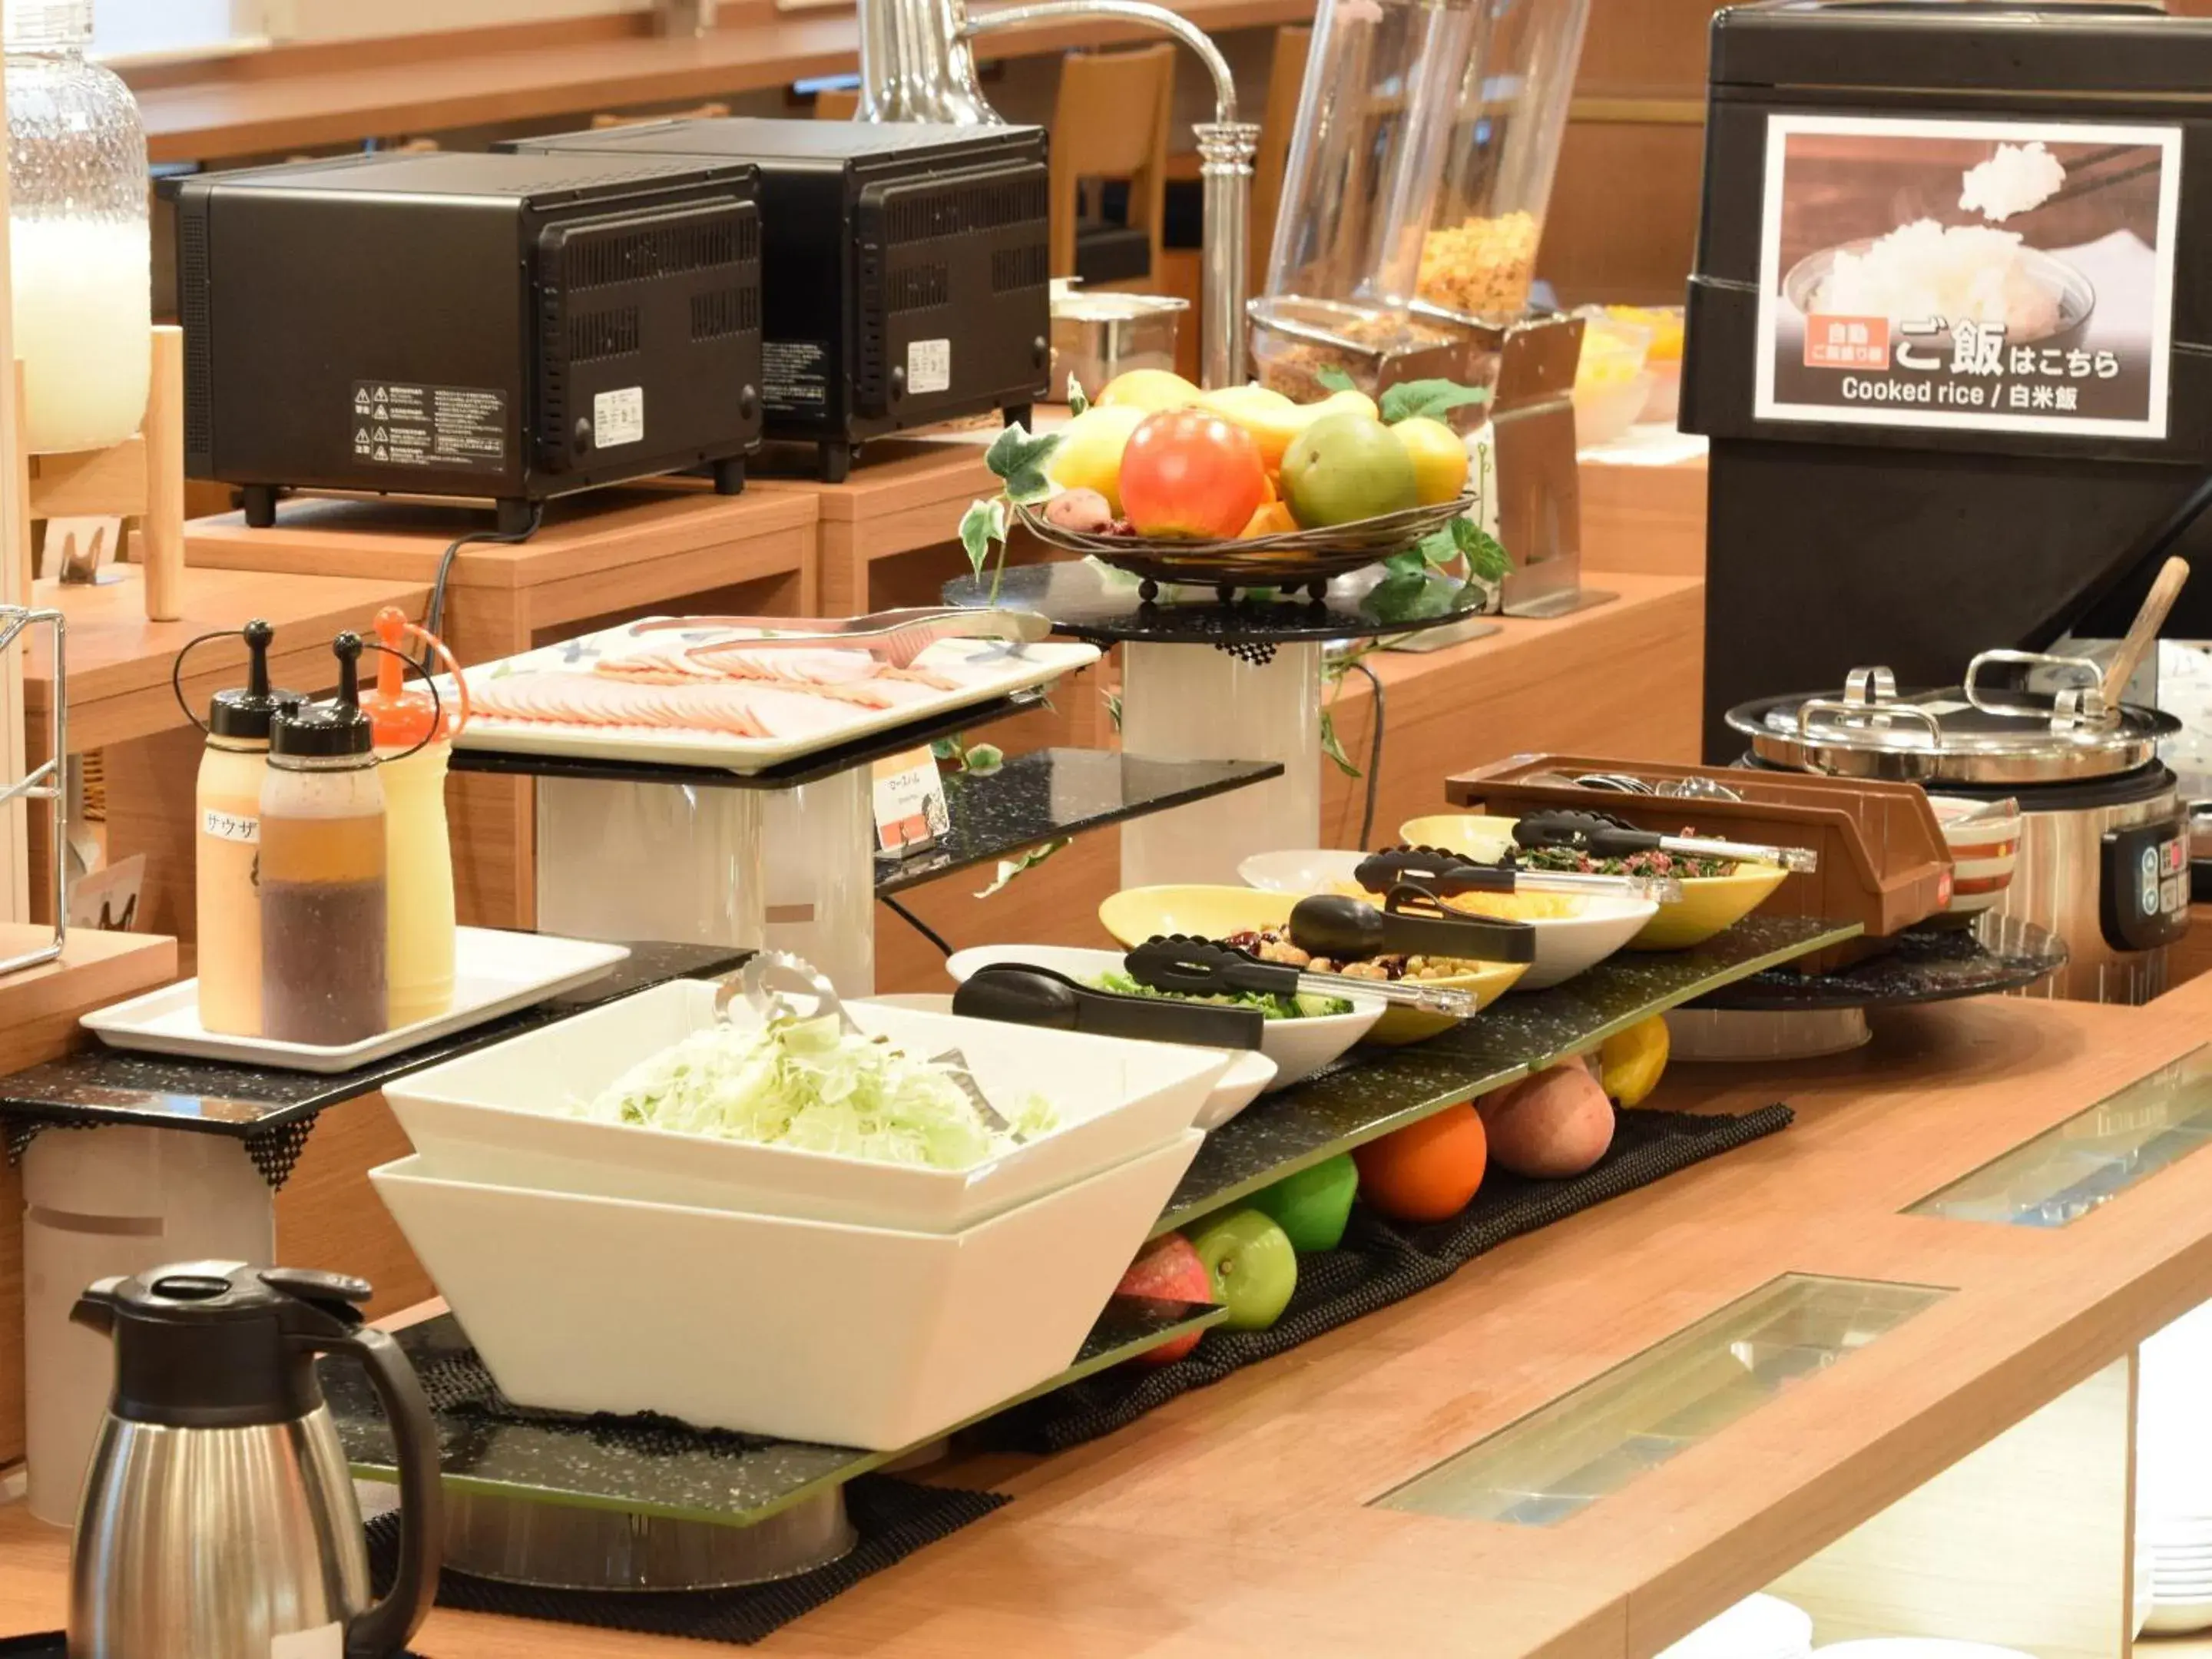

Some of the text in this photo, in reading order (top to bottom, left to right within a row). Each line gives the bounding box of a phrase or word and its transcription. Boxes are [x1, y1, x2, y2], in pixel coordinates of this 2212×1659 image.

[1896, 315, 2119, 379] ご飯はこちら
[1843, 376, 1931, 403] Cooked
[1938, 382, 1985, 406] rice
[2009, 384, 2078, 410] 白米飯
